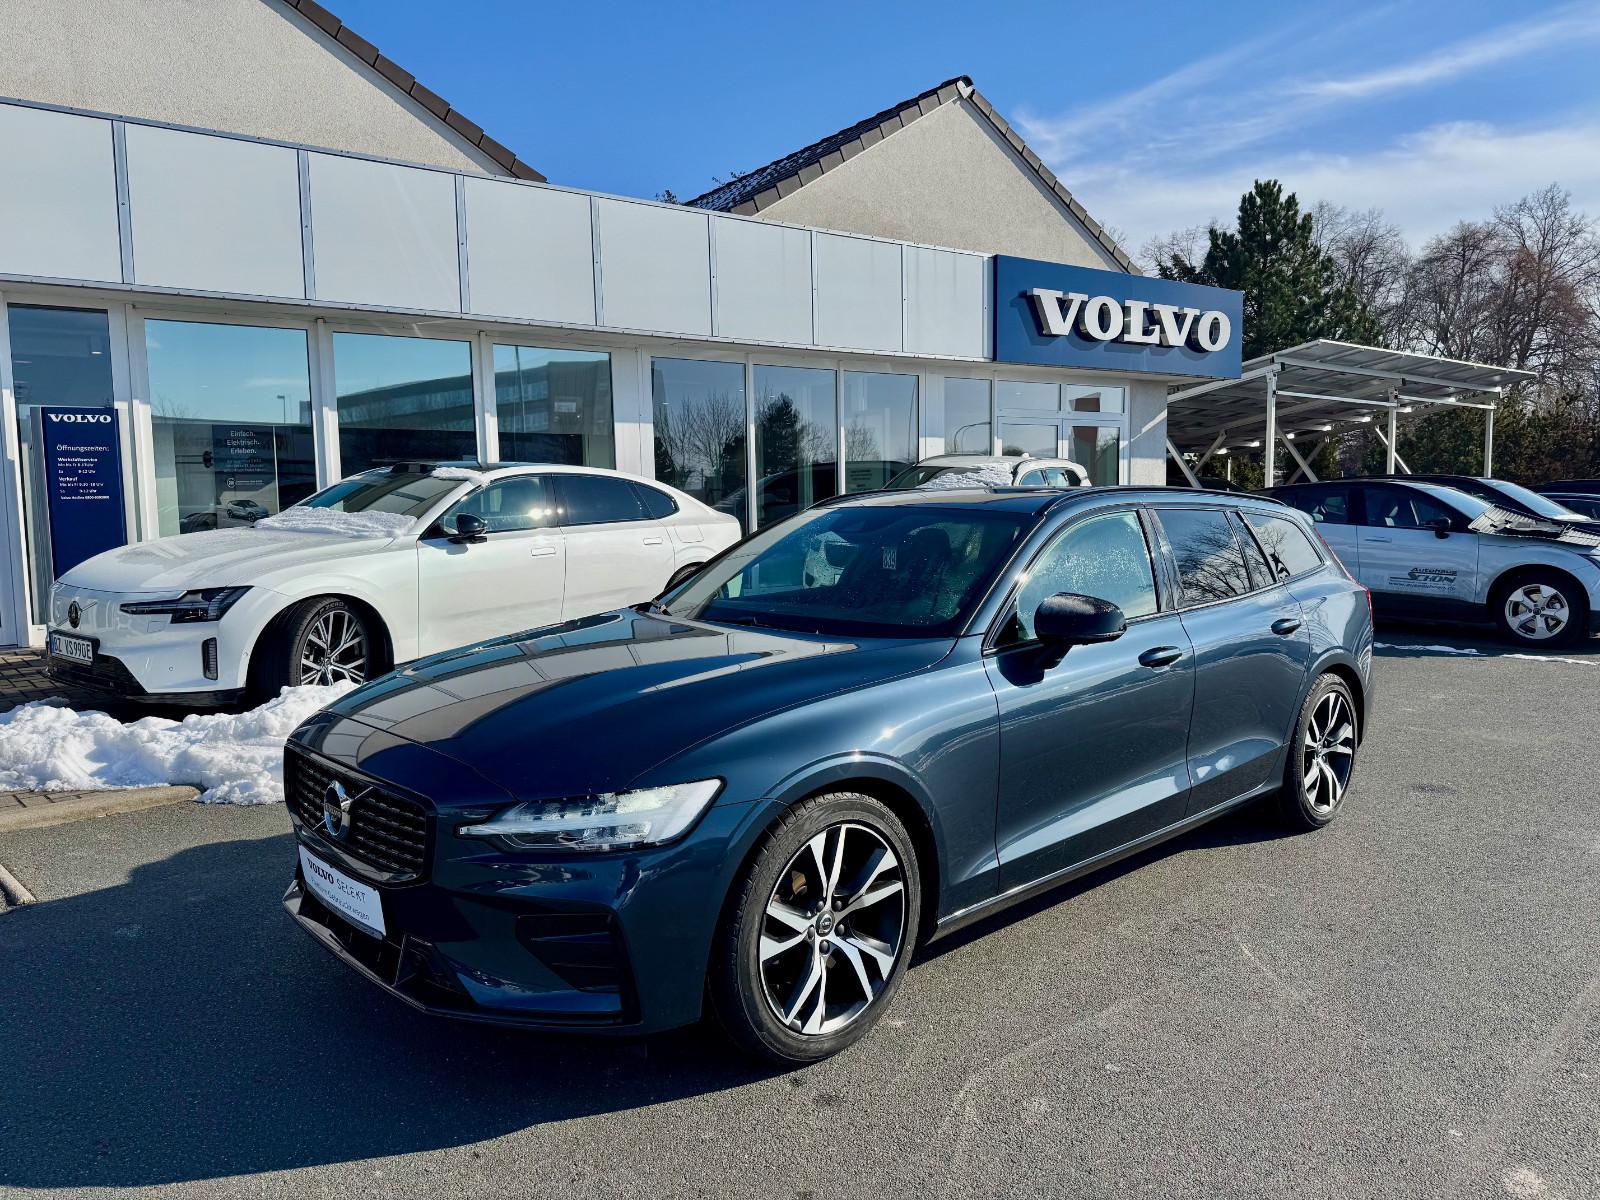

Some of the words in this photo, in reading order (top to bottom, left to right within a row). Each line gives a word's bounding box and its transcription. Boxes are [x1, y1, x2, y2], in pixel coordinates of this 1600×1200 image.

[1030, 287, 1231, 352] VOLVO
[47, 413, 112, 423] VOLVO
[56, 444, 110, 452] Öffnungszeiten:
[307, 857, 334, 885] VOLVO
[335, 878, 366, 904] SELEKT
